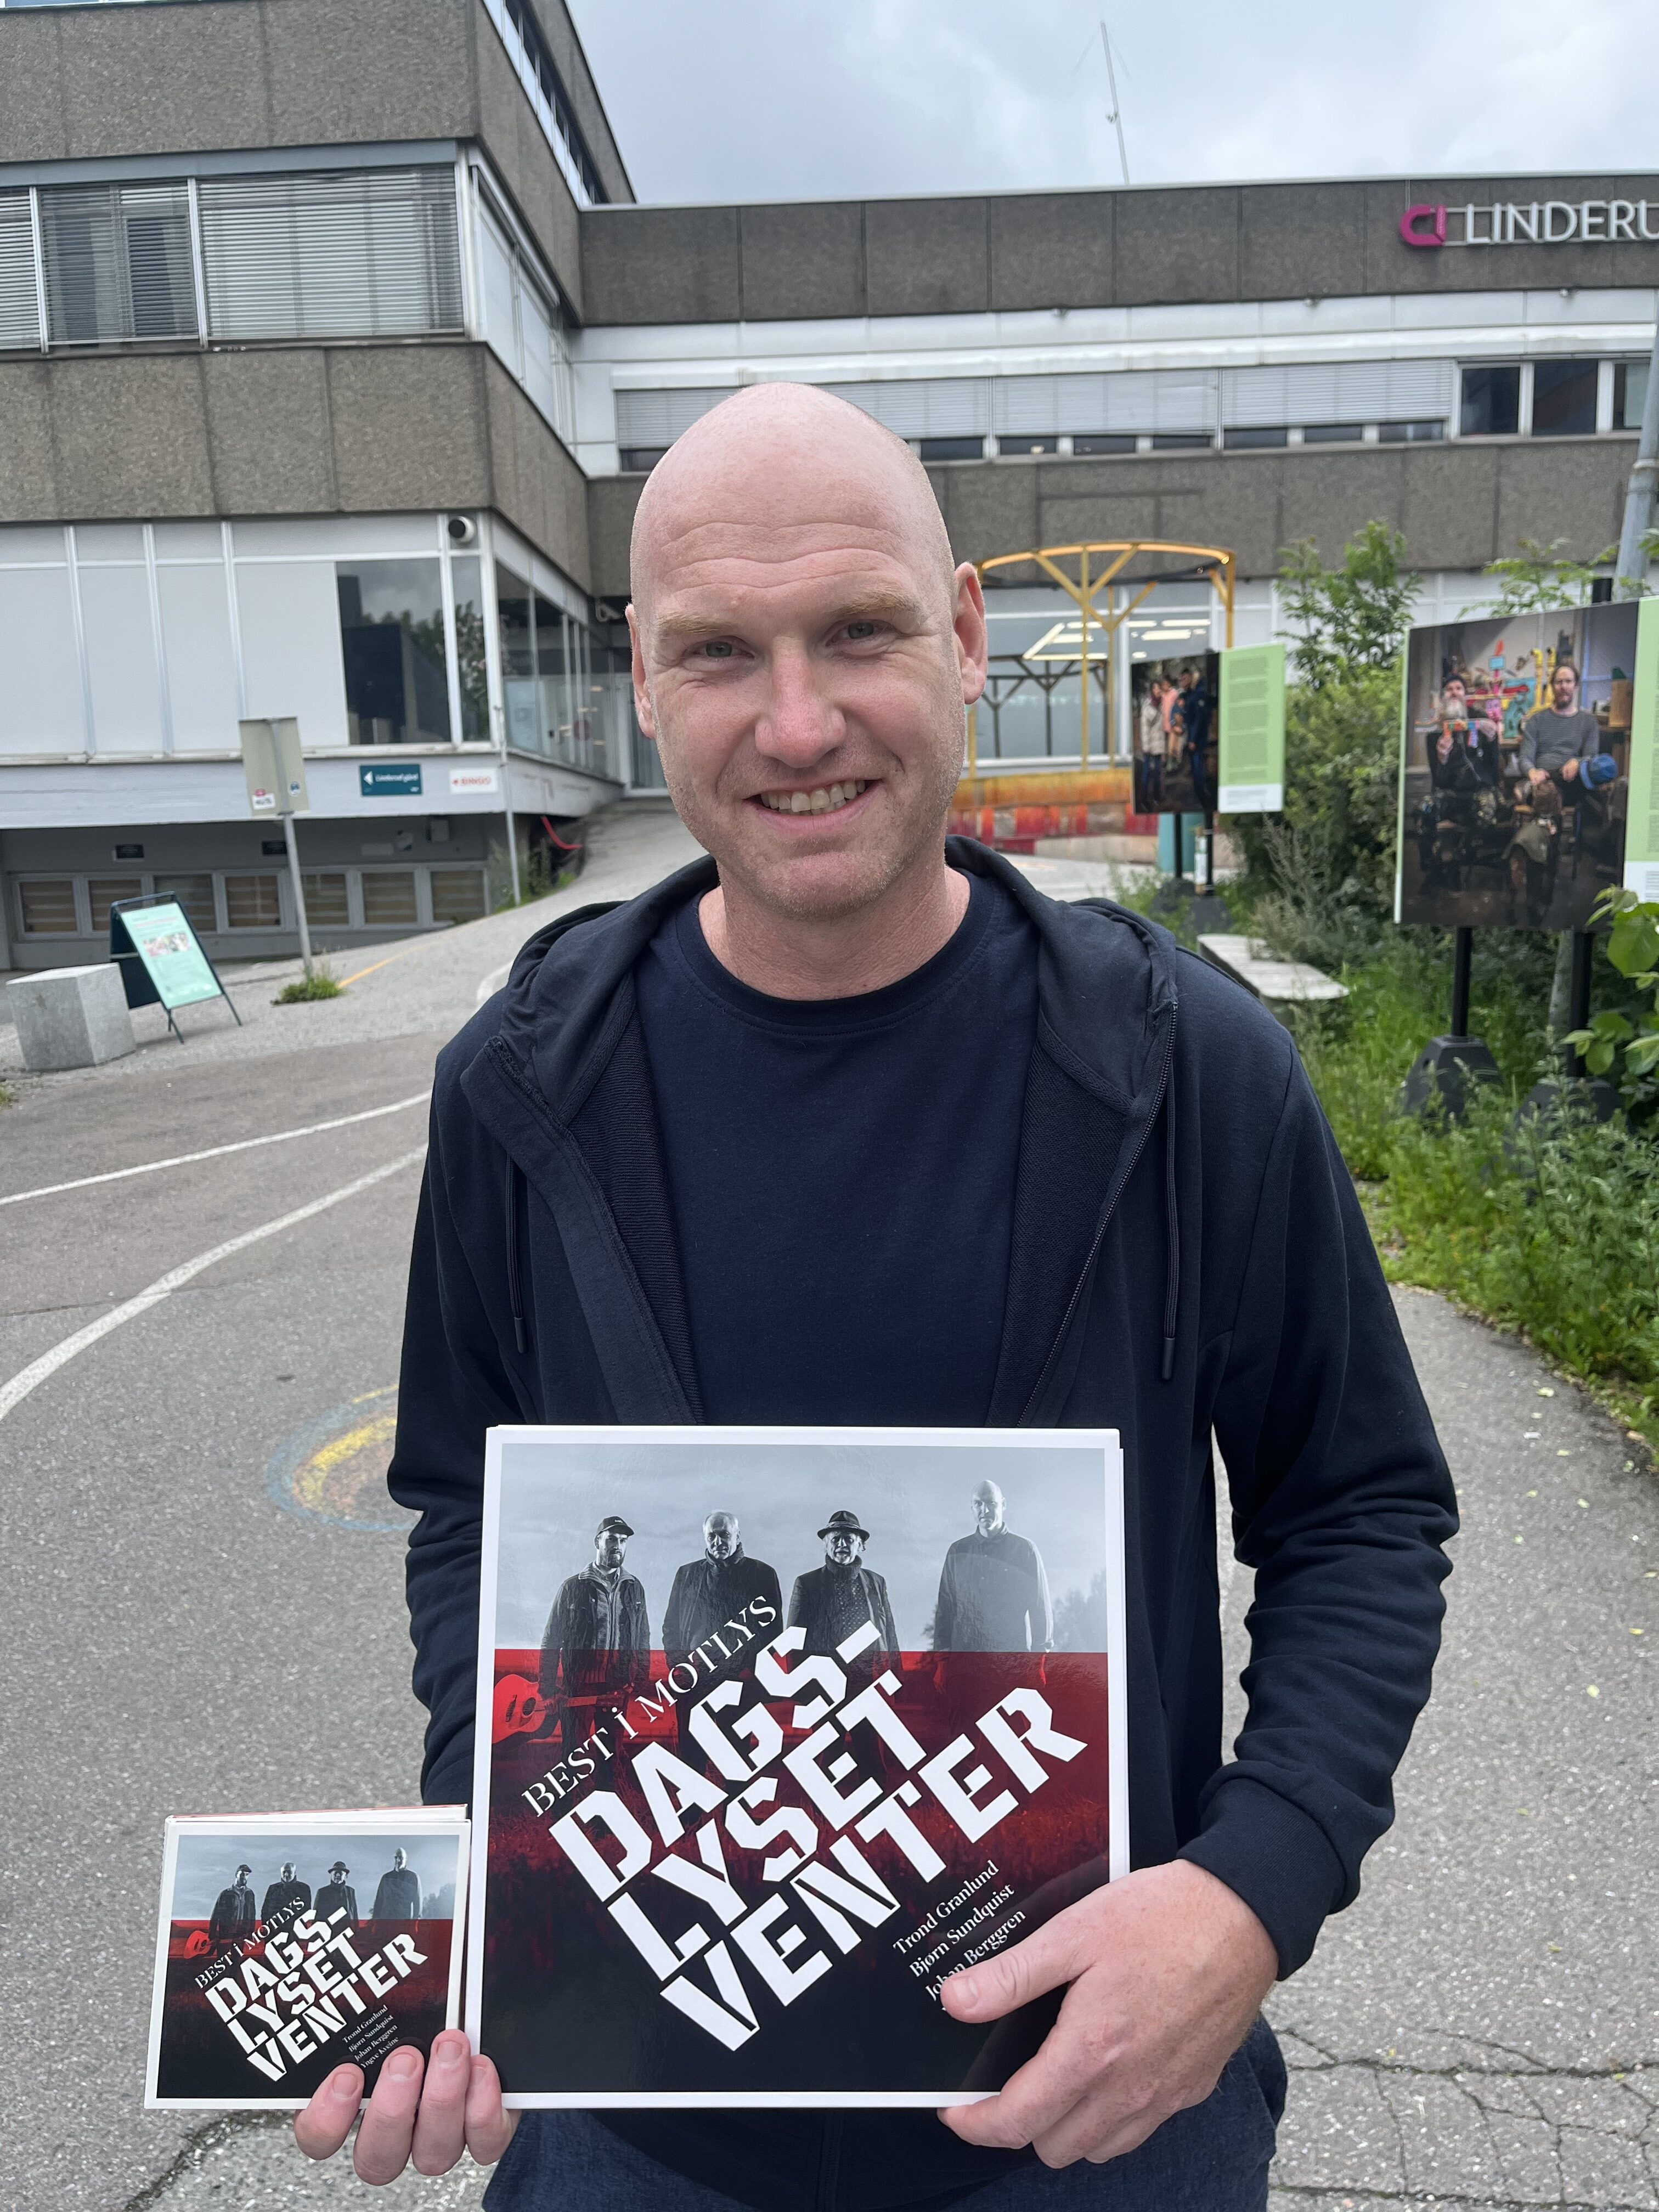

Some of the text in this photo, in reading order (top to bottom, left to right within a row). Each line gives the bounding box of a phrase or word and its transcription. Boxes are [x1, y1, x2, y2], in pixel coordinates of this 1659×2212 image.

[522, 1728, 614, 1817] BEST
[635, 1595, 777, 1723] MOTLYS
[549, 1620, 881, 1901] DAGS-
[607, 1670, 926, 1981] LYSET
[660, 1688, 1088, 2051] VENTER
[194, 1951, 233, 1989] BEST
[244, 1897, 304, 1950] MOTLYS
[893, 1860, 999, 1955] Trond Granlund
[909, 1884, 1015, 1977] Bjørn Sundquist
[963, 1910, 1026, 1965] Berggren
[205, 1906, 347, 2023] DAGS-
[227, 1928, 363, 2053] LYSET
[247, 1933, 428, 2081] VENTER
[342, 2004, 388, 2043] Trond Granlund
[354, 2024, 398, 2062] Johan Berggren
[364, 2015, 394, 2039] Sundquist
